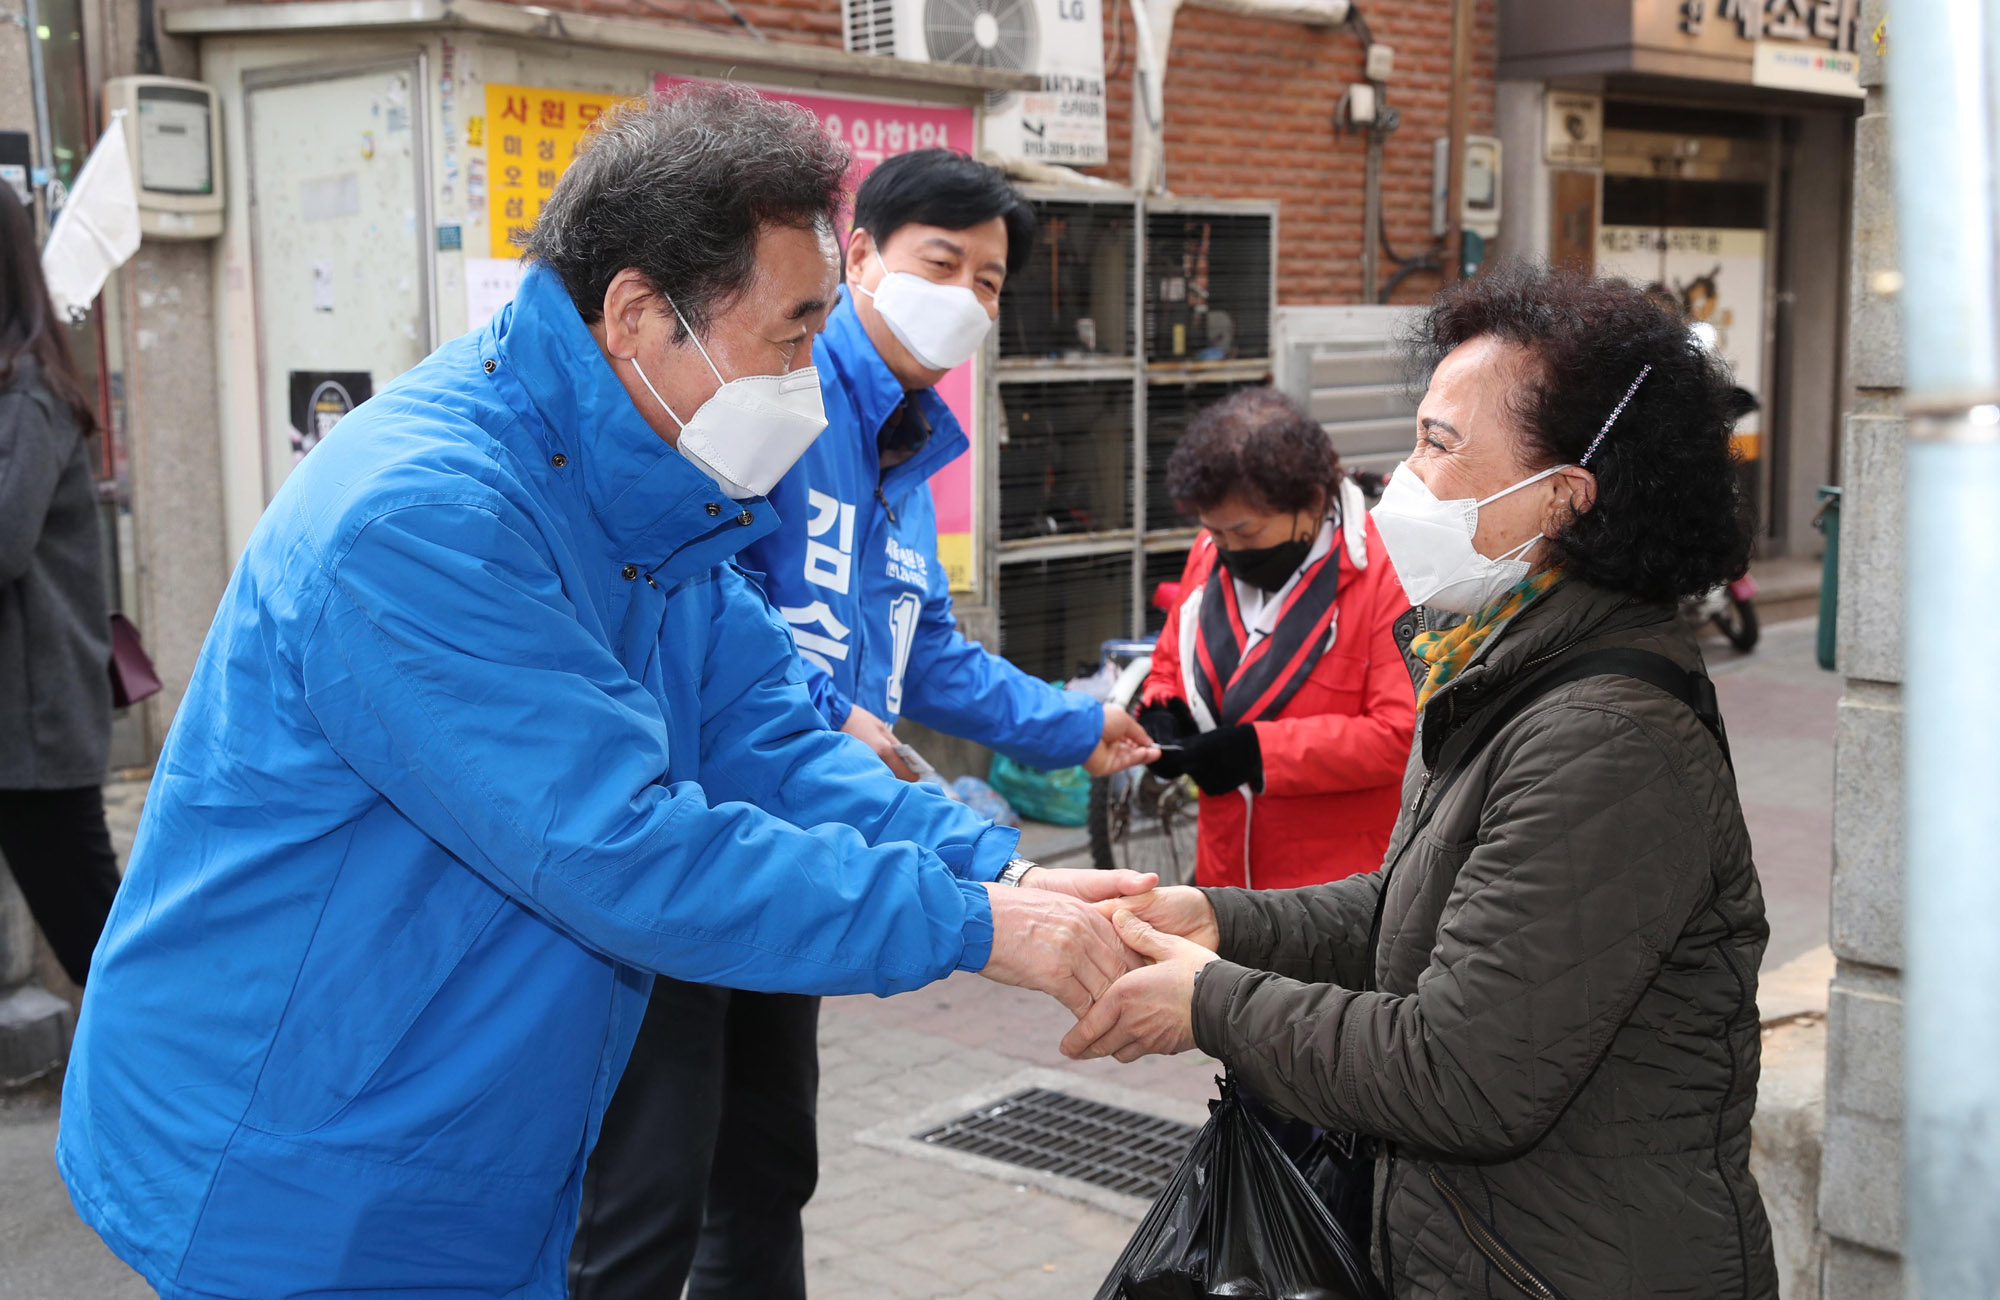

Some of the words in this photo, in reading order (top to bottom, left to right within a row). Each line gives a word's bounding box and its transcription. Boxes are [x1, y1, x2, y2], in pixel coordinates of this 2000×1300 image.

[1058, 0, 1085, 21] LG
[825, 113, 949, 166] 악학원
[886, 591, 922, 715] 1
